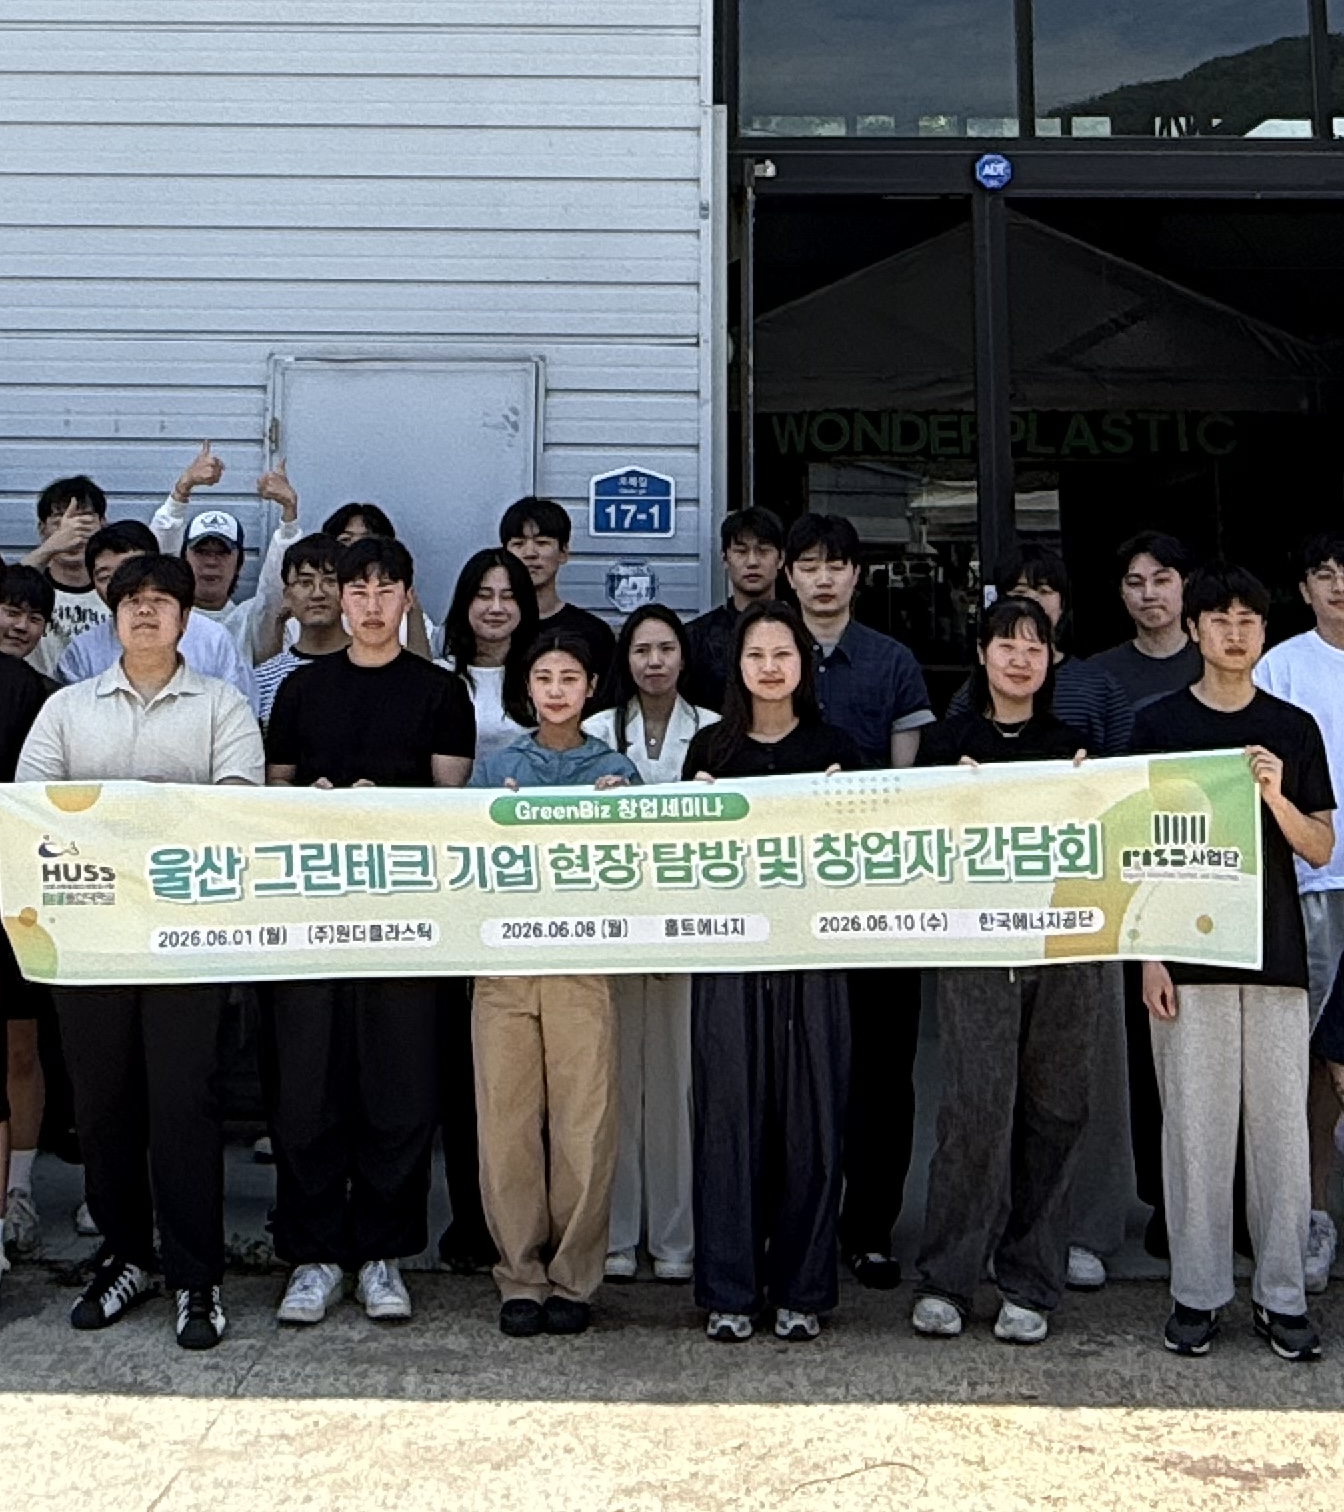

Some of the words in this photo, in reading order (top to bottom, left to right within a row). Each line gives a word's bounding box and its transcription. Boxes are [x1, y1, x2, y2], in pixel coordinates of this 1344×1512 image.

[605, 504, 660, 529] 17-1
[515, 801, 612, 820] GreenBiz
[149, 846, 244, 900] 울산
[254, 843, 434, 892] 그린테크
[447, 844, 534, 889] 기업
[549, 842, 644, 886] 현장
[652, 840, 745, 886] 탐방
[757, 835, 798, 883] 및
[813, 827, 954, 882] 창업자
[962, 822, 1099, 877] 간담회
[42, 863, 116, 882] HUSS
[501, 920, 596, 940] 2026.06.08
[818, 915, 915, 934] 2026.06.10
[920, 912, 949, 932] (수)
[978, 909, 1095, 932] 한국에너지공단
[158, 929, 253, 949] 2026.06.01
